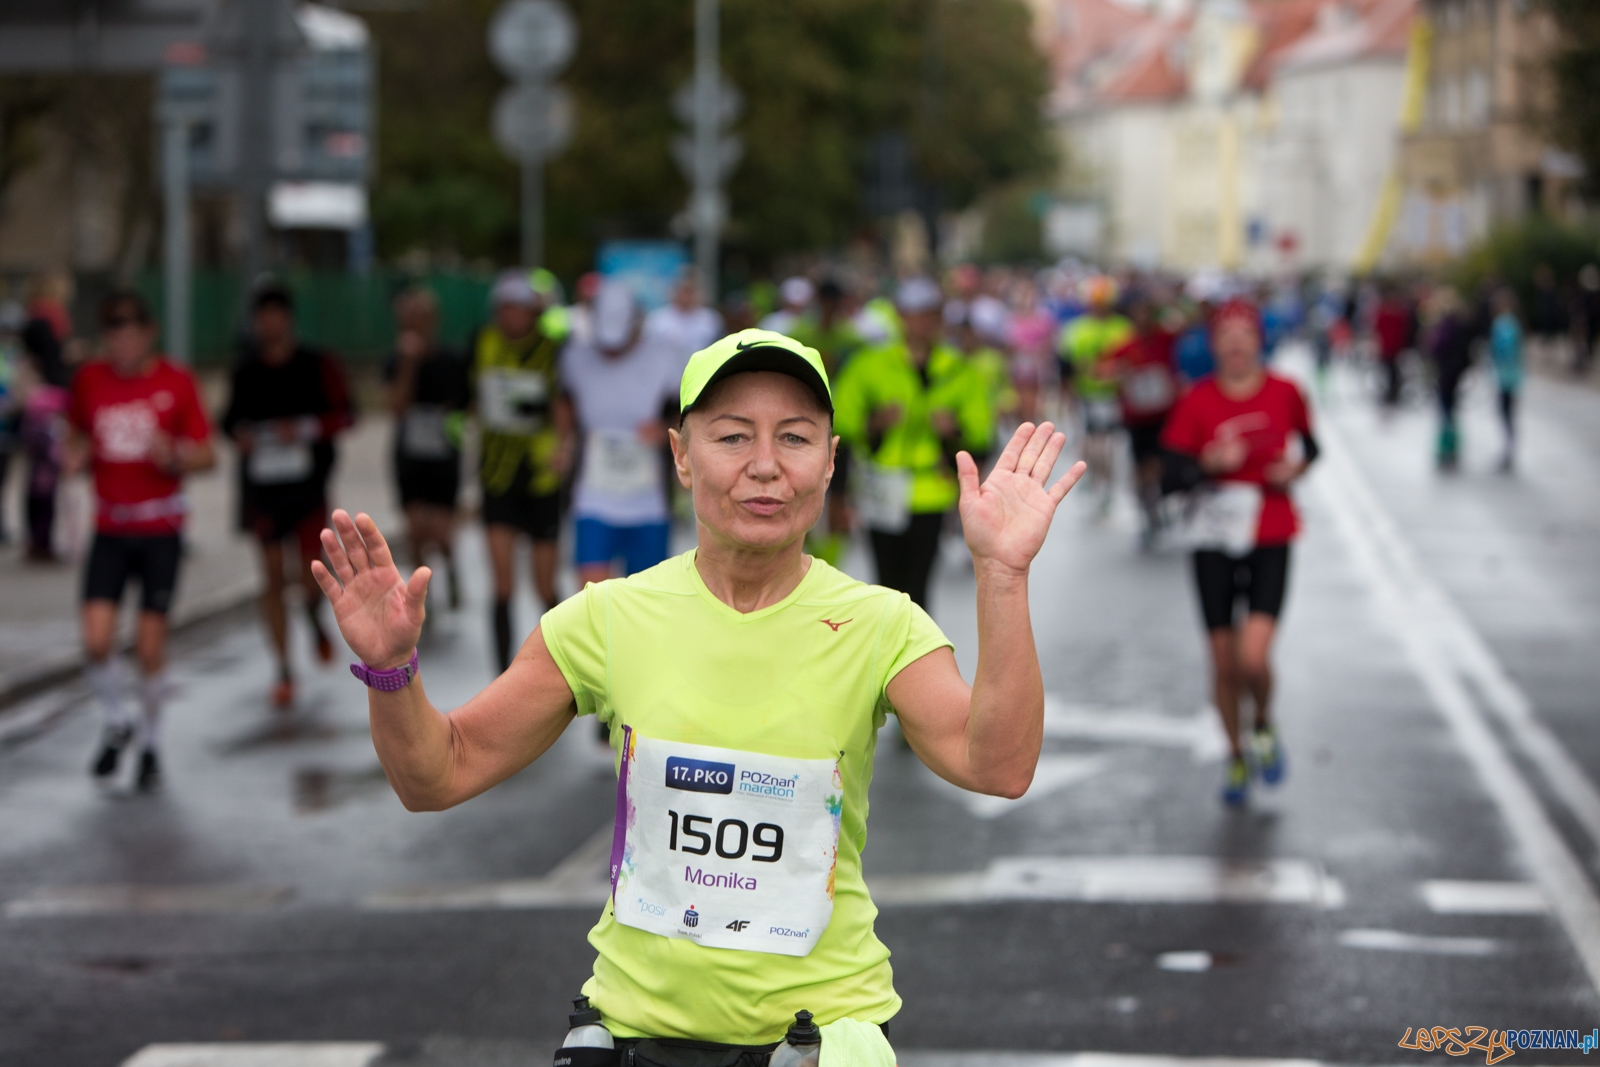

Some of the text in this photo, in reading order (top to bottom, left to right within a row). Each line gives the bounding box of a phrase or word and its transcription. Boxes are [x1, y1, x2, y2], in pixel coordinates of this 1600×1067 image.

[672, 766, 728, 785] 17. PKO
[739, 782, 794, 798] maraton
[668, 810, 784, 862] 1509
[684, 865, 757, 890] Monika
[726, 919, 751, 933] 4F
